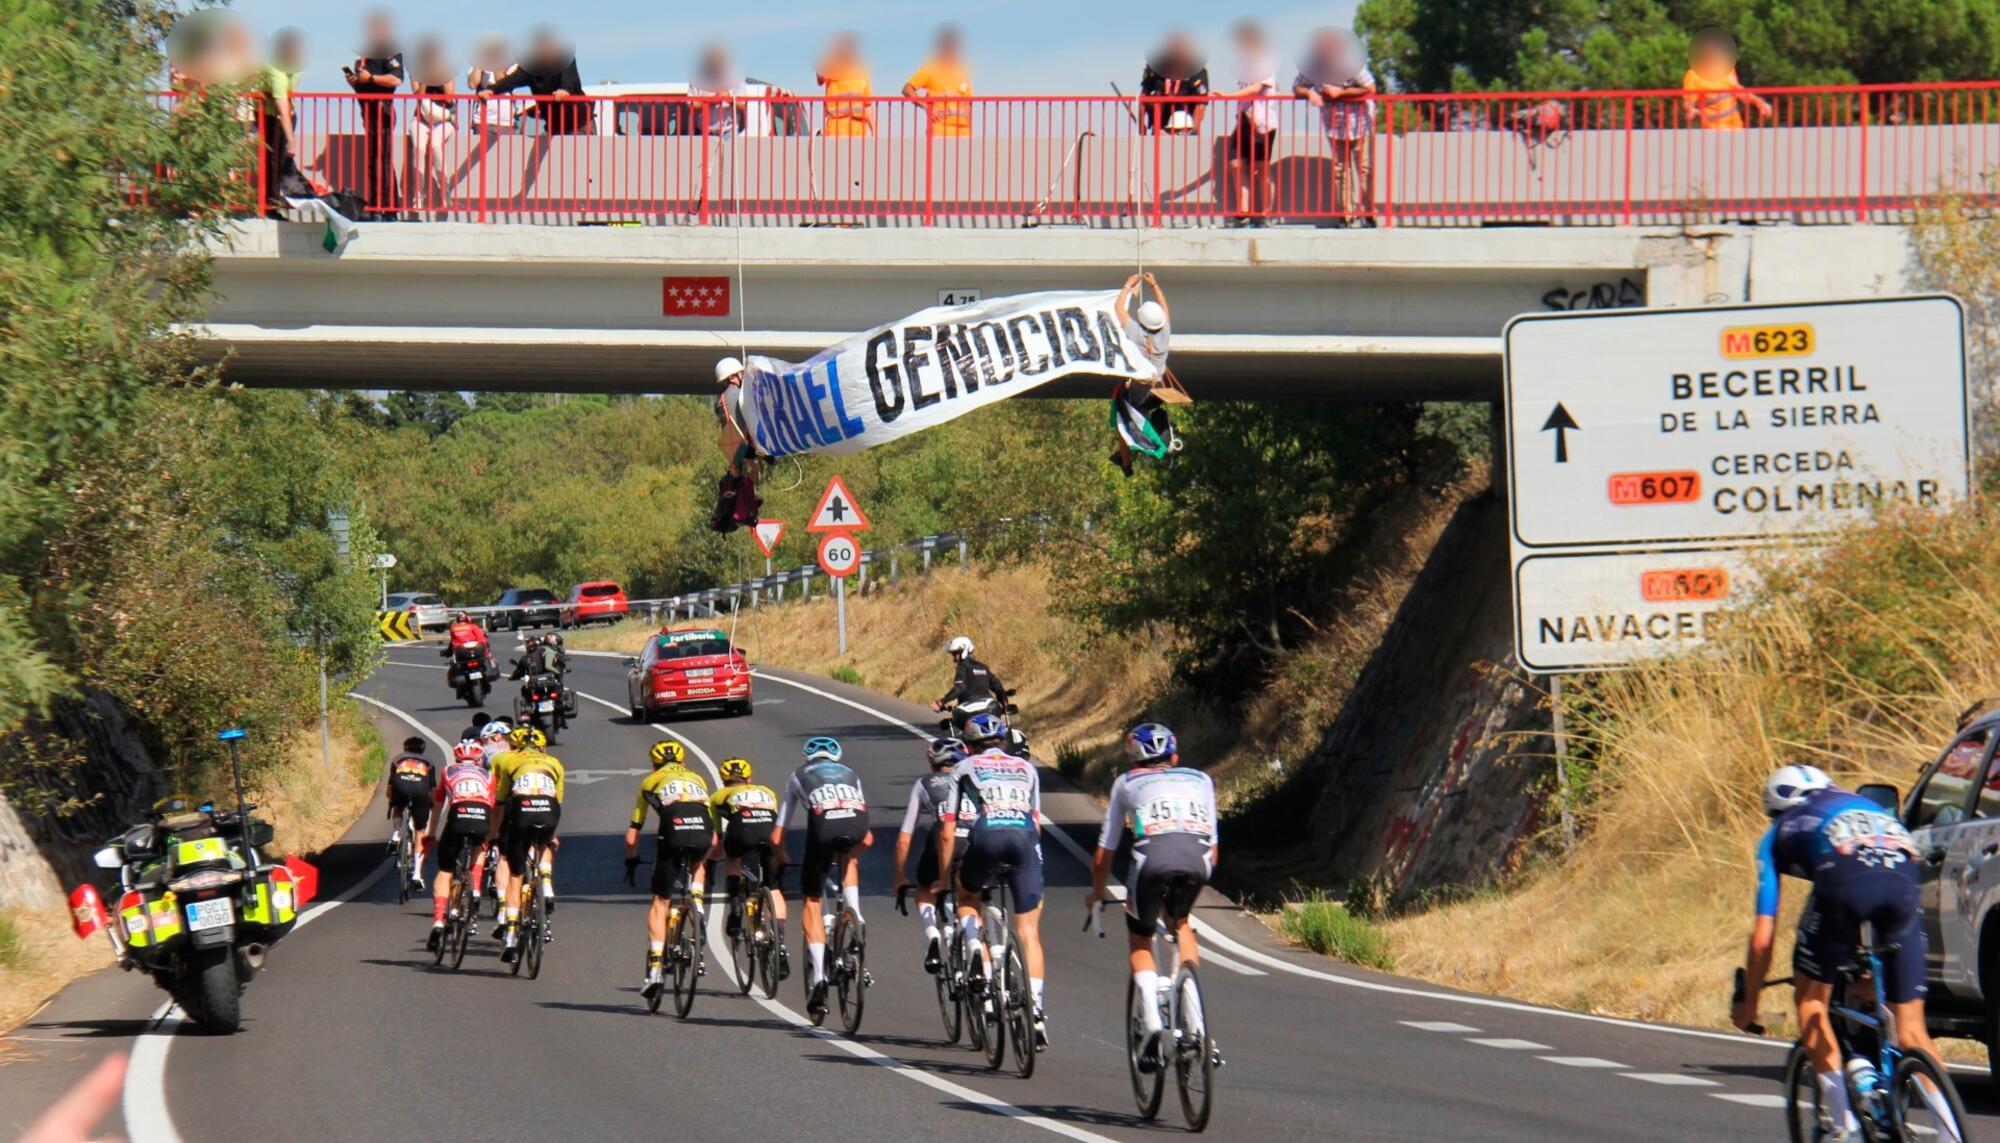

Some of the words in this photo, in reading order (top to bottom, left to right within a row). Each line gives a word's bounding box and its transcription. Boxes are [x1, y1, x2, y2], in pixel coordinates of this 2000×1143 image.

[1726, 330, 1808, 353] M623
[1672, 365, 1867, 400] BECERRIL
[1661, 412, 1698, 433] DE
[1715, 409, 1750, 431] LA
[1771, 403, 1880, 428] SIERRA
[1711, 450, 1854, 476] CERCEDA
[1615, 476, 1695, 499] M607
[1713, 479, 1940, 515] COLMENAR
[828, 548, 851, 562] 60
[1539, 611, 1729, 643] NAVACER
[517, 774, 529, 788] 15
[664, 783, 676, 796] 16
[813, 786, 835, 803] 115
[986, 786, 1003, 801] 41
[1010, 788, 1025, 802] 41
[987, 809, 1025, 819] BORA
[1150, 801, 1170, 820] 45
